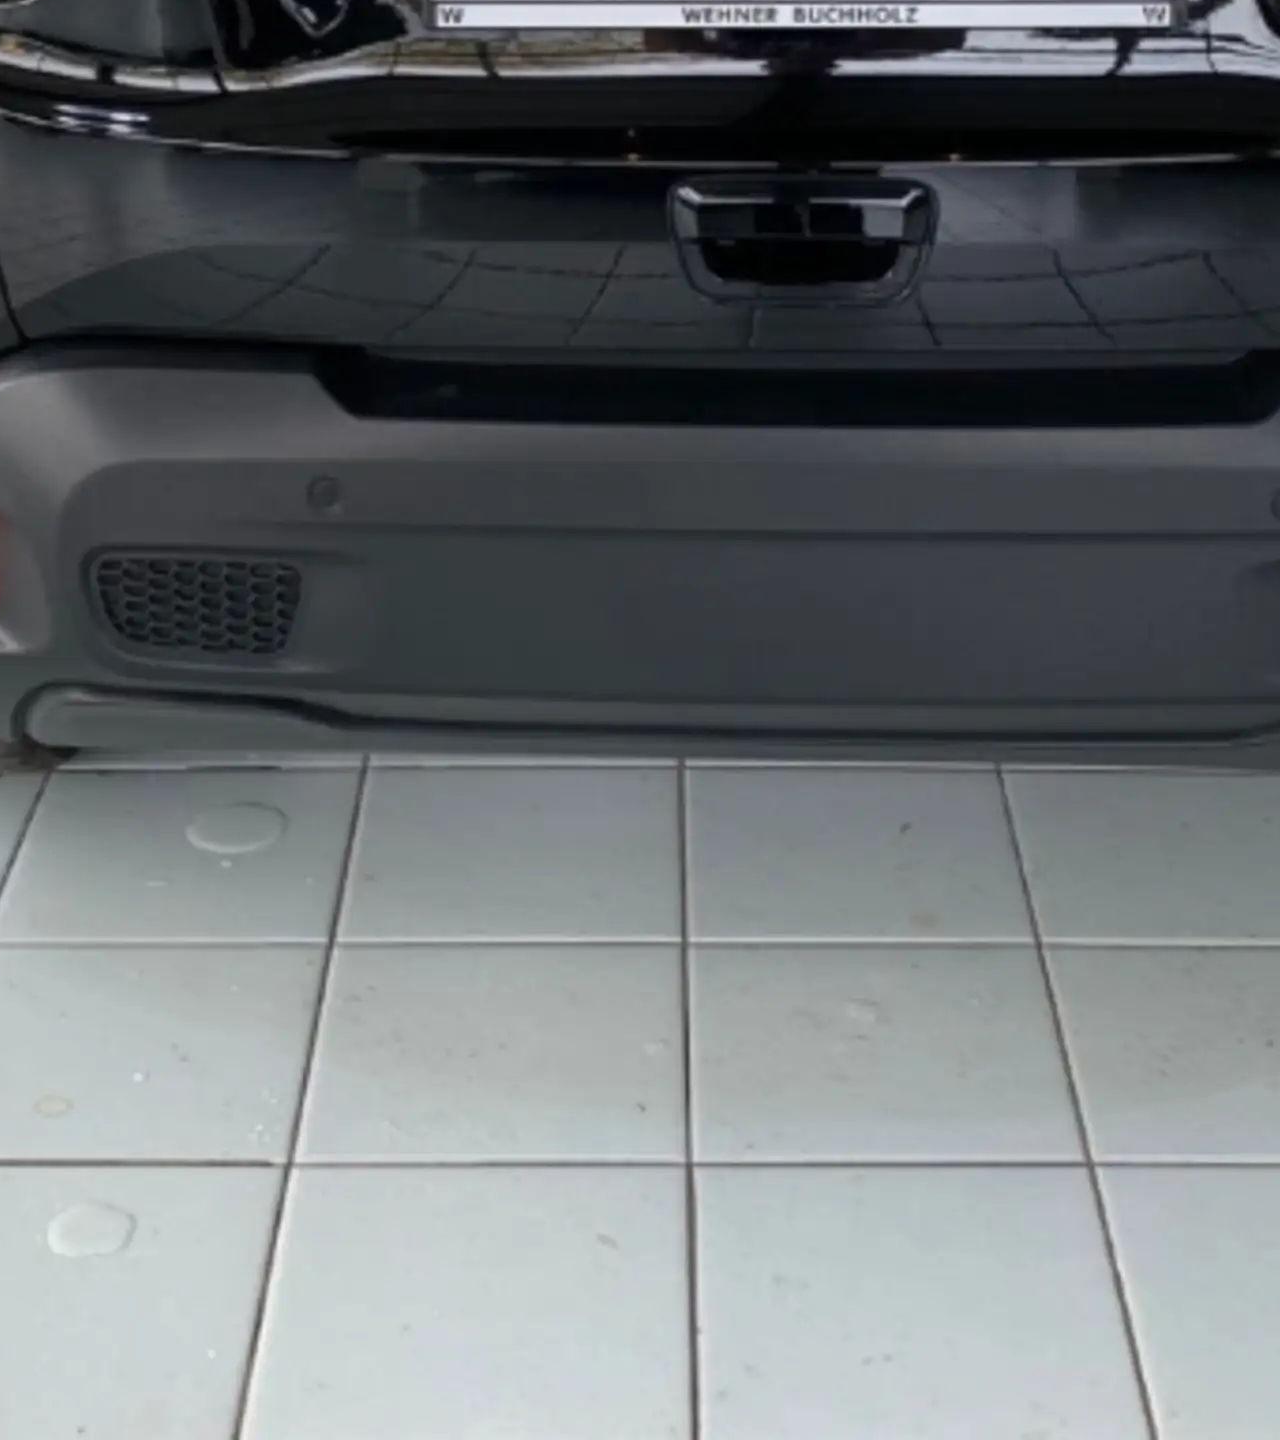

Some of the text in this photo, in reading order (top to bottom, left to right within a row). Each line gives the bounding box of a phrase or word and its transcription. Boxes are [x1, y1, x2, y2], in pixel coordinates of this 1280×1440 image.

[441, 8, 464, 23] W
[681, 7, 919, 23] WEHNER BUCHHOLZ
